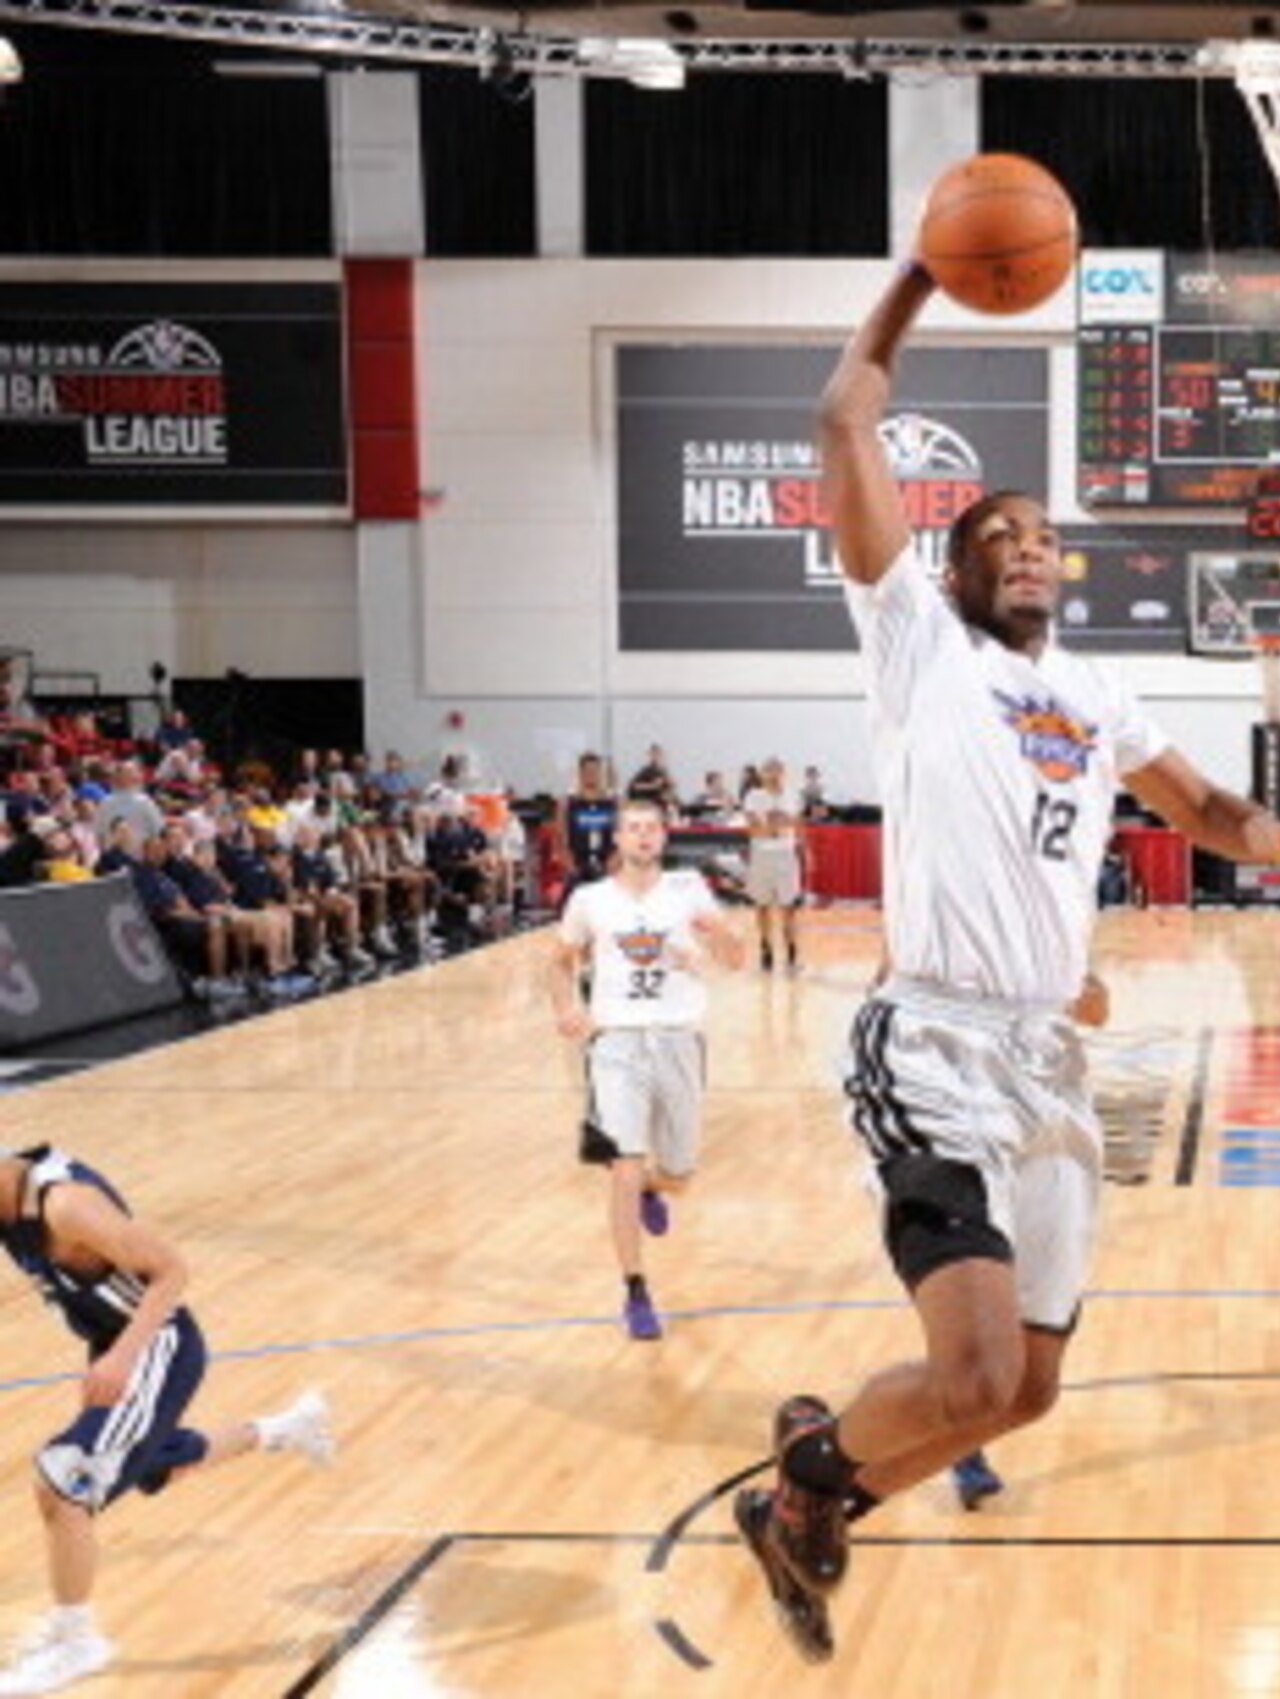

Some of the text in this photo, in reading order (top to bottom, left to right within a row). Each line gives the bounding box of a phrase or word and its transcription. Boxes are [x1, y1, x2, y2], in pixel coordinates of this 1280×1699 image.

[86, 415, 228, 454] LEAGUE
[683, 441, 822, 467] SAMSUN
[683, 480, 773, 525] NBA
[1031, 792, 1077, 861] 12
